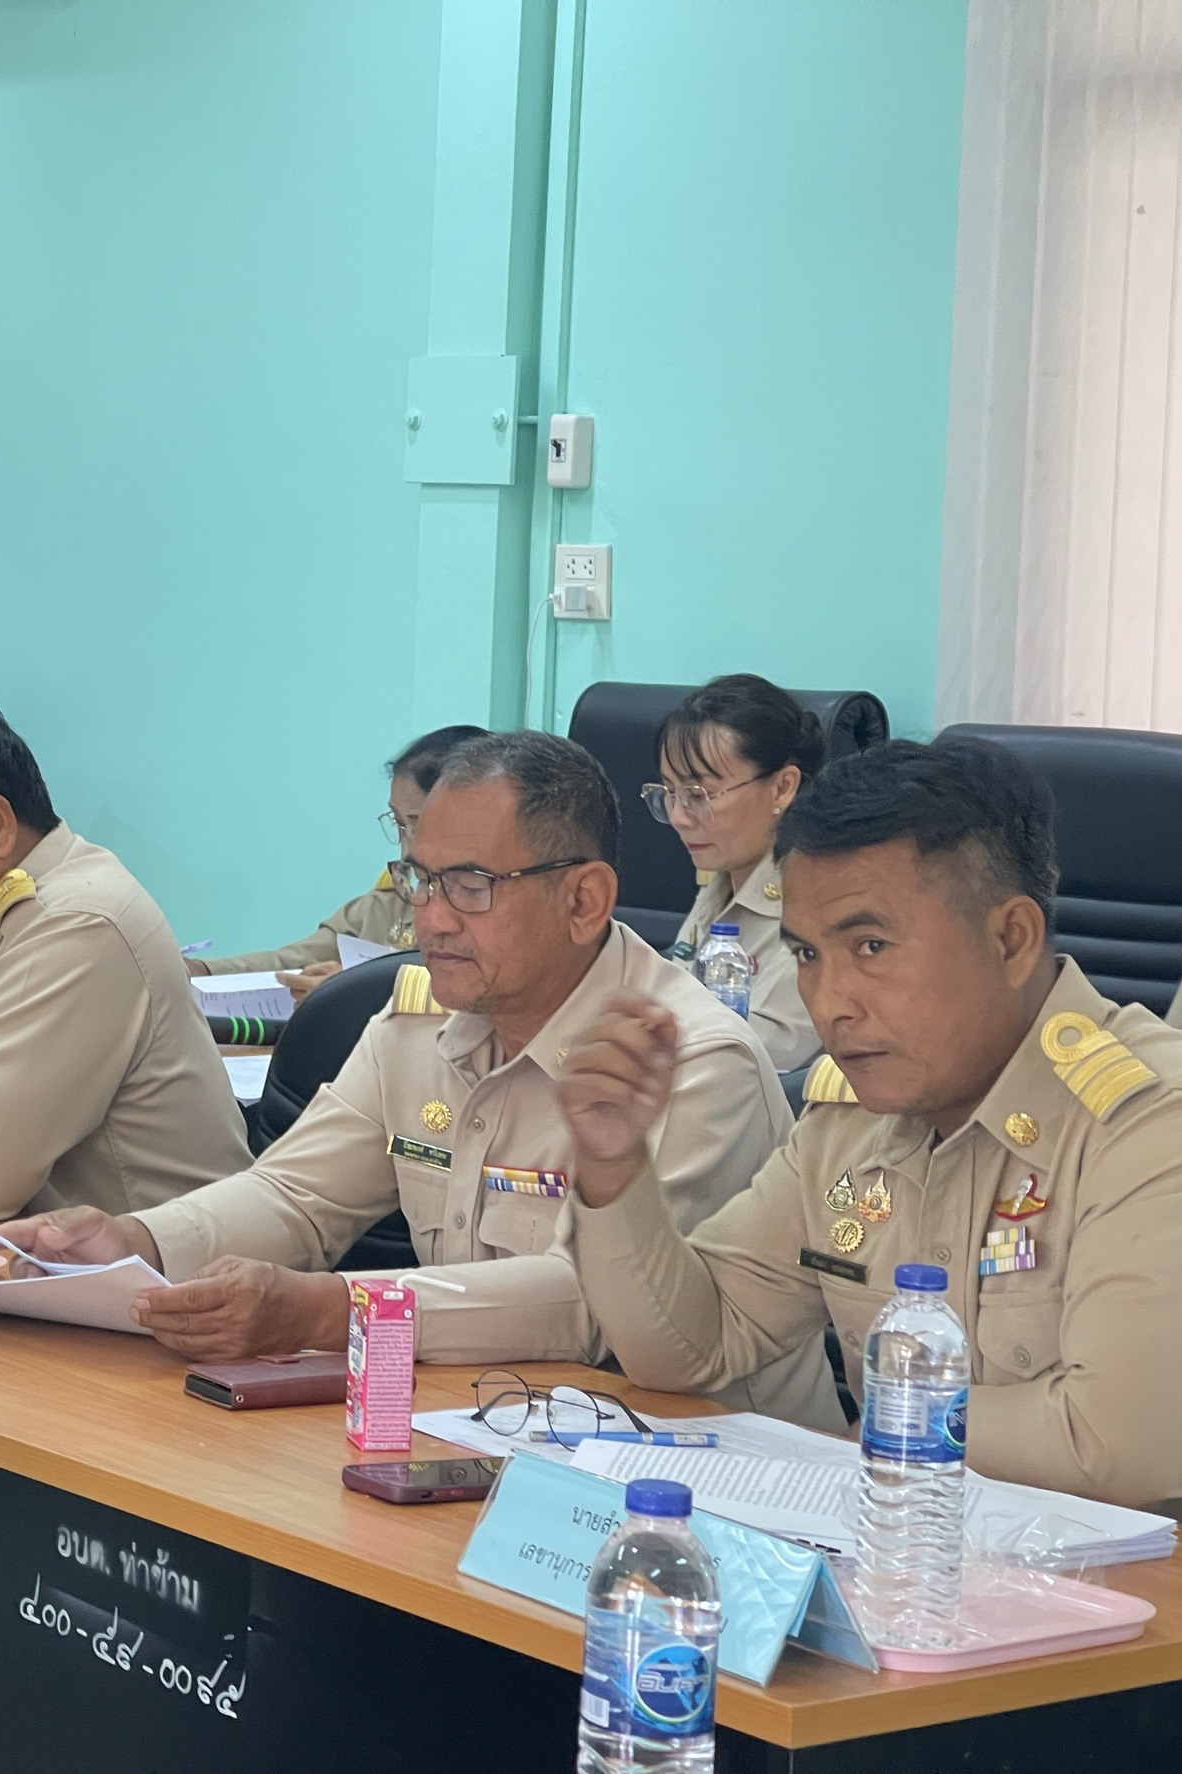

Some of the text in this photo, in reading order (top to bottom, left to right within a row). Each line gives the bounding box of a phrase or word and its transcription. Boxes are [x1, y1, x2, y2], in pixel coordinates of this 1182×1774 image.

[572, 1506, 621, 1536] นายสำ
[119, 1540, 200, 1614] ท่าข้าม
